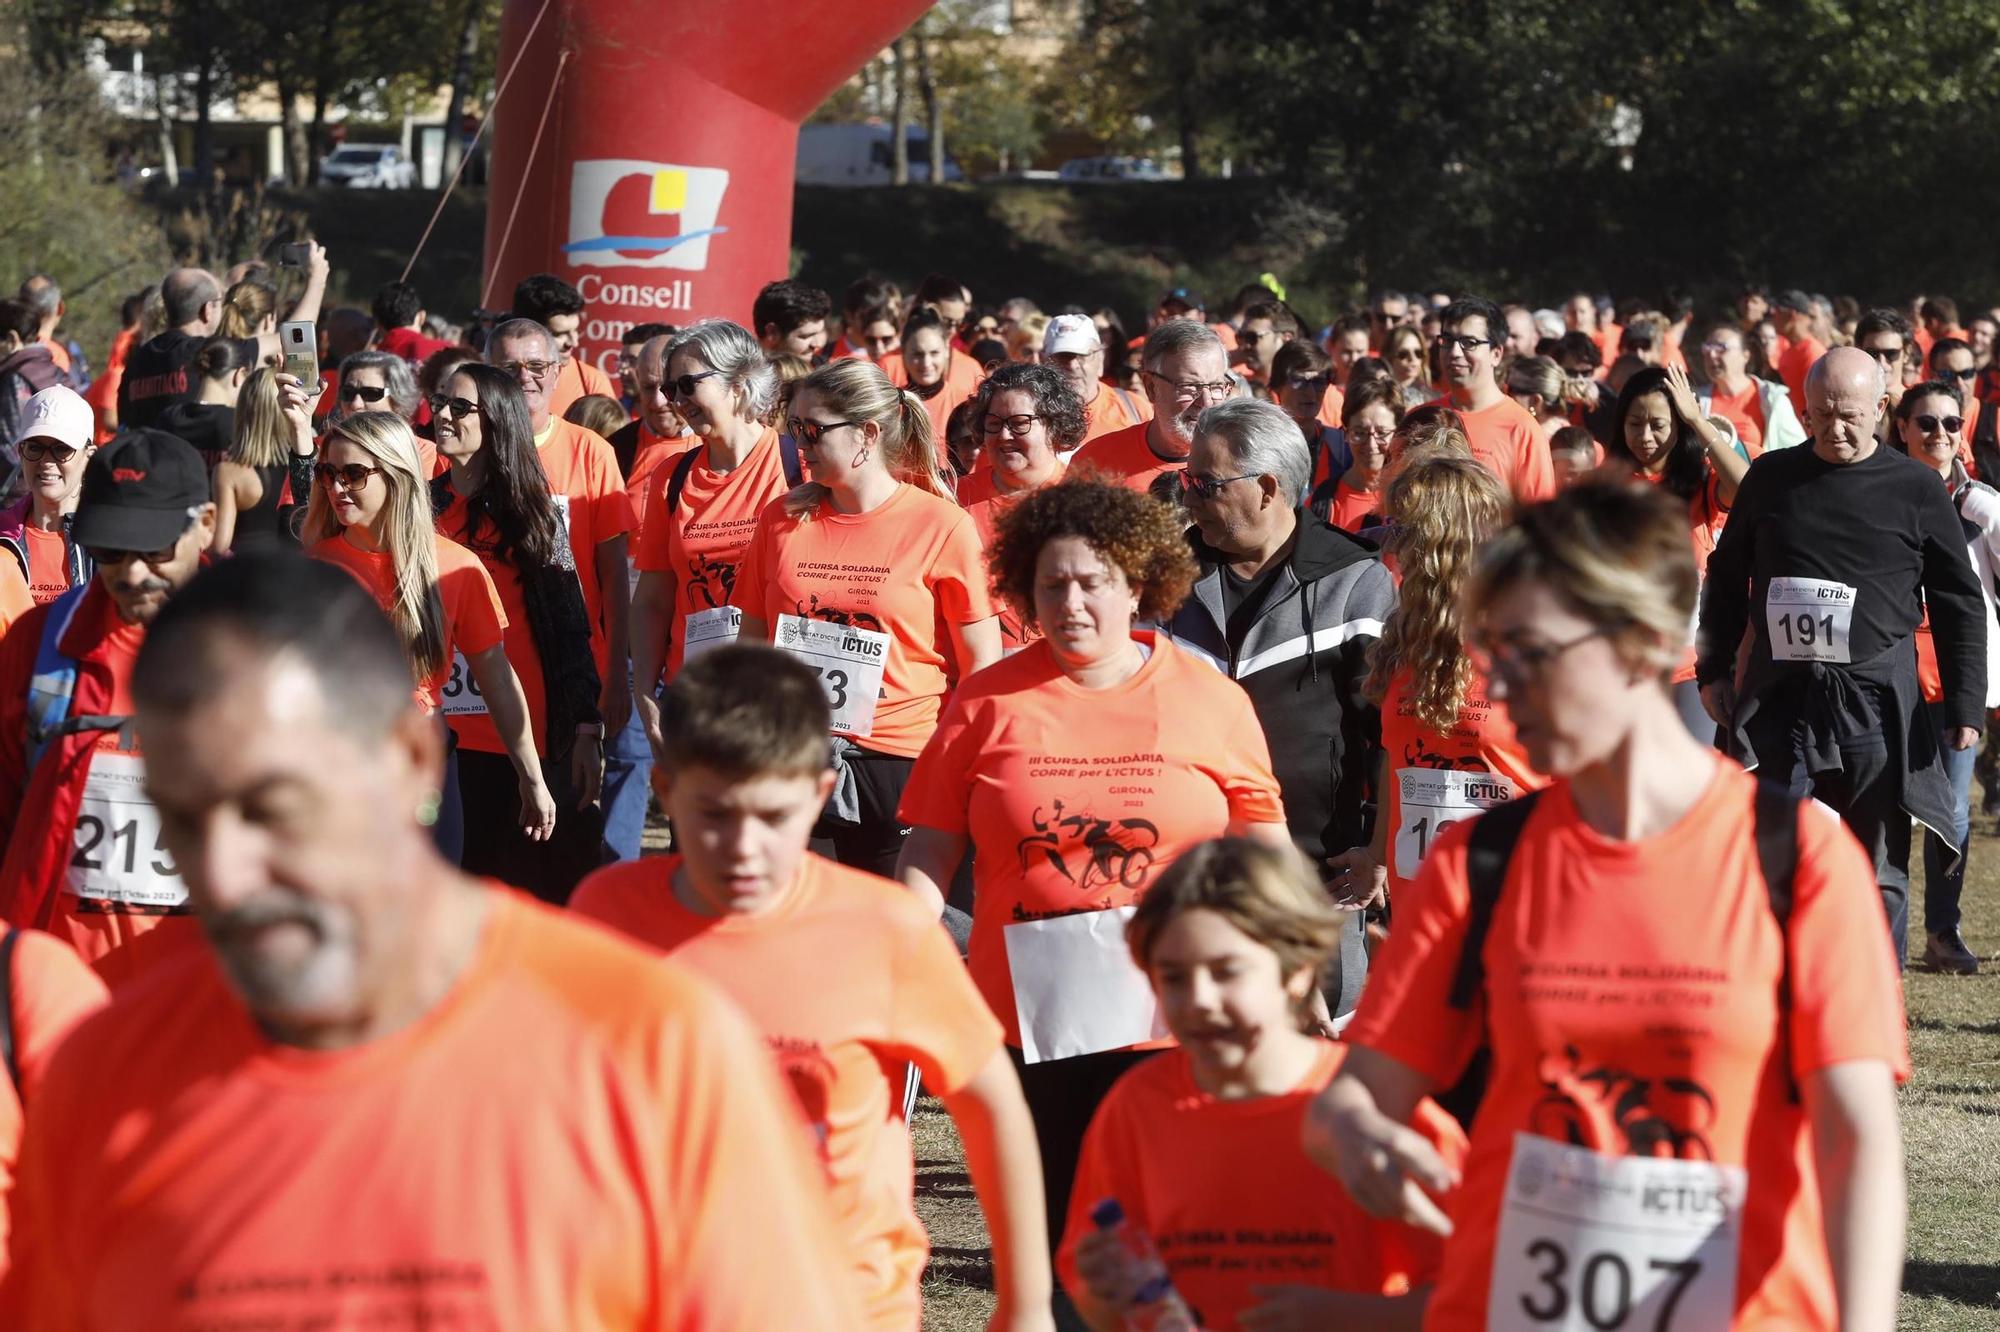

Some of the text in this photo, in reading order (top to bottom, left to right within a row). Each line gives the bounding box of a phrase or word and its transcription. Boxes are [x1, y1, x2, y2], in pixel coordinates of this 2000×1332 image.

[576, 274, 693, 311] Consell
[691, 522, 719, 531] CURSA
[721, 516, 760, 528] SOLIDÀRI
[682, 531, 711, 540] CORRE
[712, 530, 728, 540] per
[729, 540, 752, 548] GIRON
[808, 562, 839, 571] CURSA
[841, 564, 891, 574] SOLIDÀRIA
[797, 571, 829, 579] CORRE
[848, 574, 882, 583] L'ICTUS
[848, 588, 878, 596] GIRONA
[1817, 587, 1850, 600] ICTUS
[1778, 613, 1834, 646] 191
[842, 636, 882, 657] ICTUS
[1029, 752, 1164, 765] III CURSA SOLIDÀRIA
[1030, 768, 1076, 777] CORRE
[1078, 769, 1102, 778] per
[1106, 768, 1154, 777] L'ICTUS
[1108, 786, 1154, 794] GIRONA
[1464, 783, 1509, 800] ICTUS
[1642, 1187, 1729, 1217] ICTUS
[1520, 1236, 1704, 1332] 307
